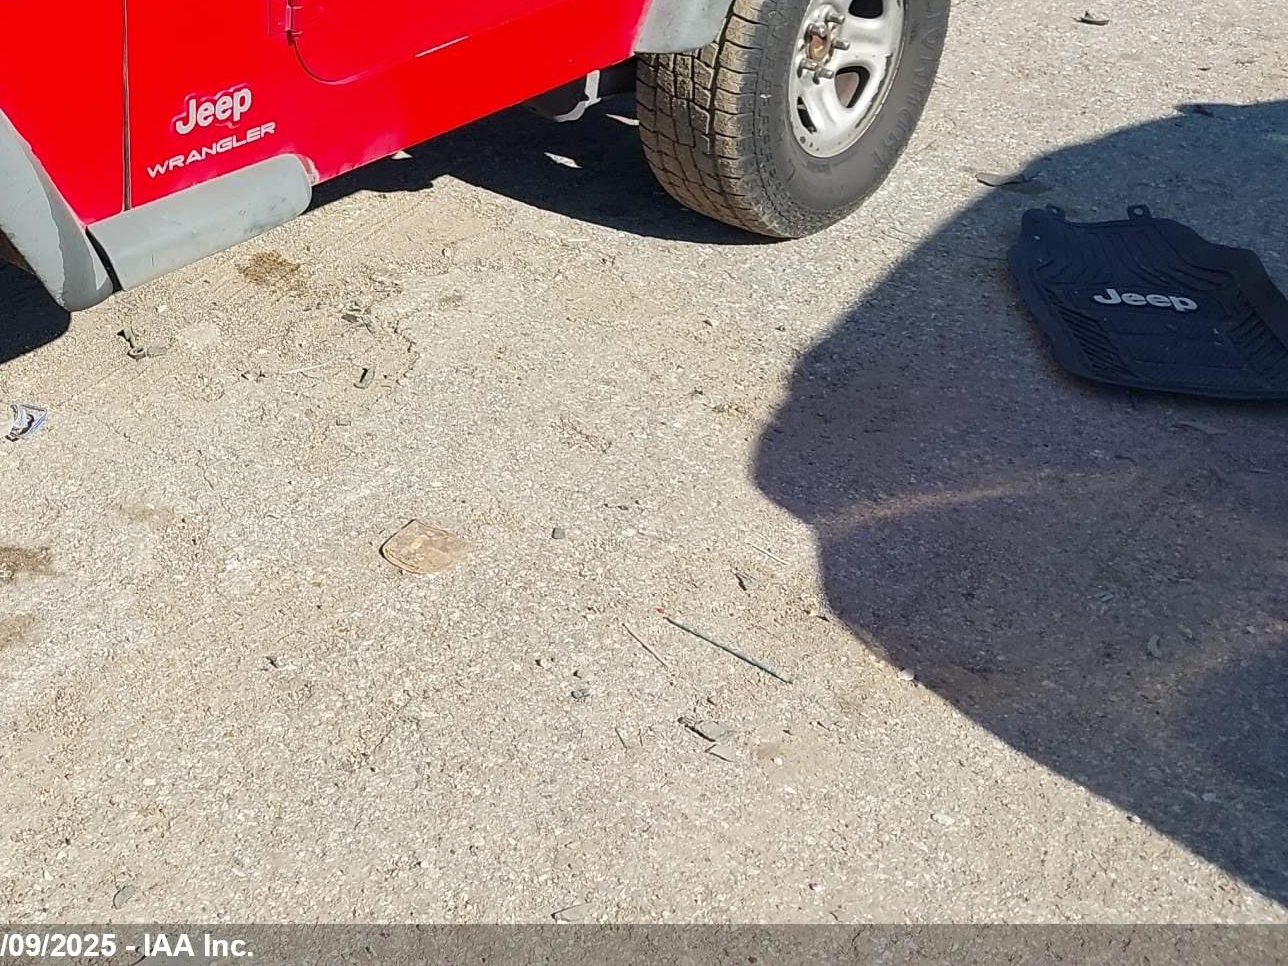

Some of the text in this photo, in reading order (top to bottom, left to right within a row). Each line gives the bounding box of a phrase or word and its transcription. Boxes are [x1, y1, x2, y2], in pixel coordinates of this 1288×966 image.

[175, 87, 252, 134] Jeep
[147, 122, 276, 178] WRANGLER
[1093, 288, 1198, 312] Jeep
